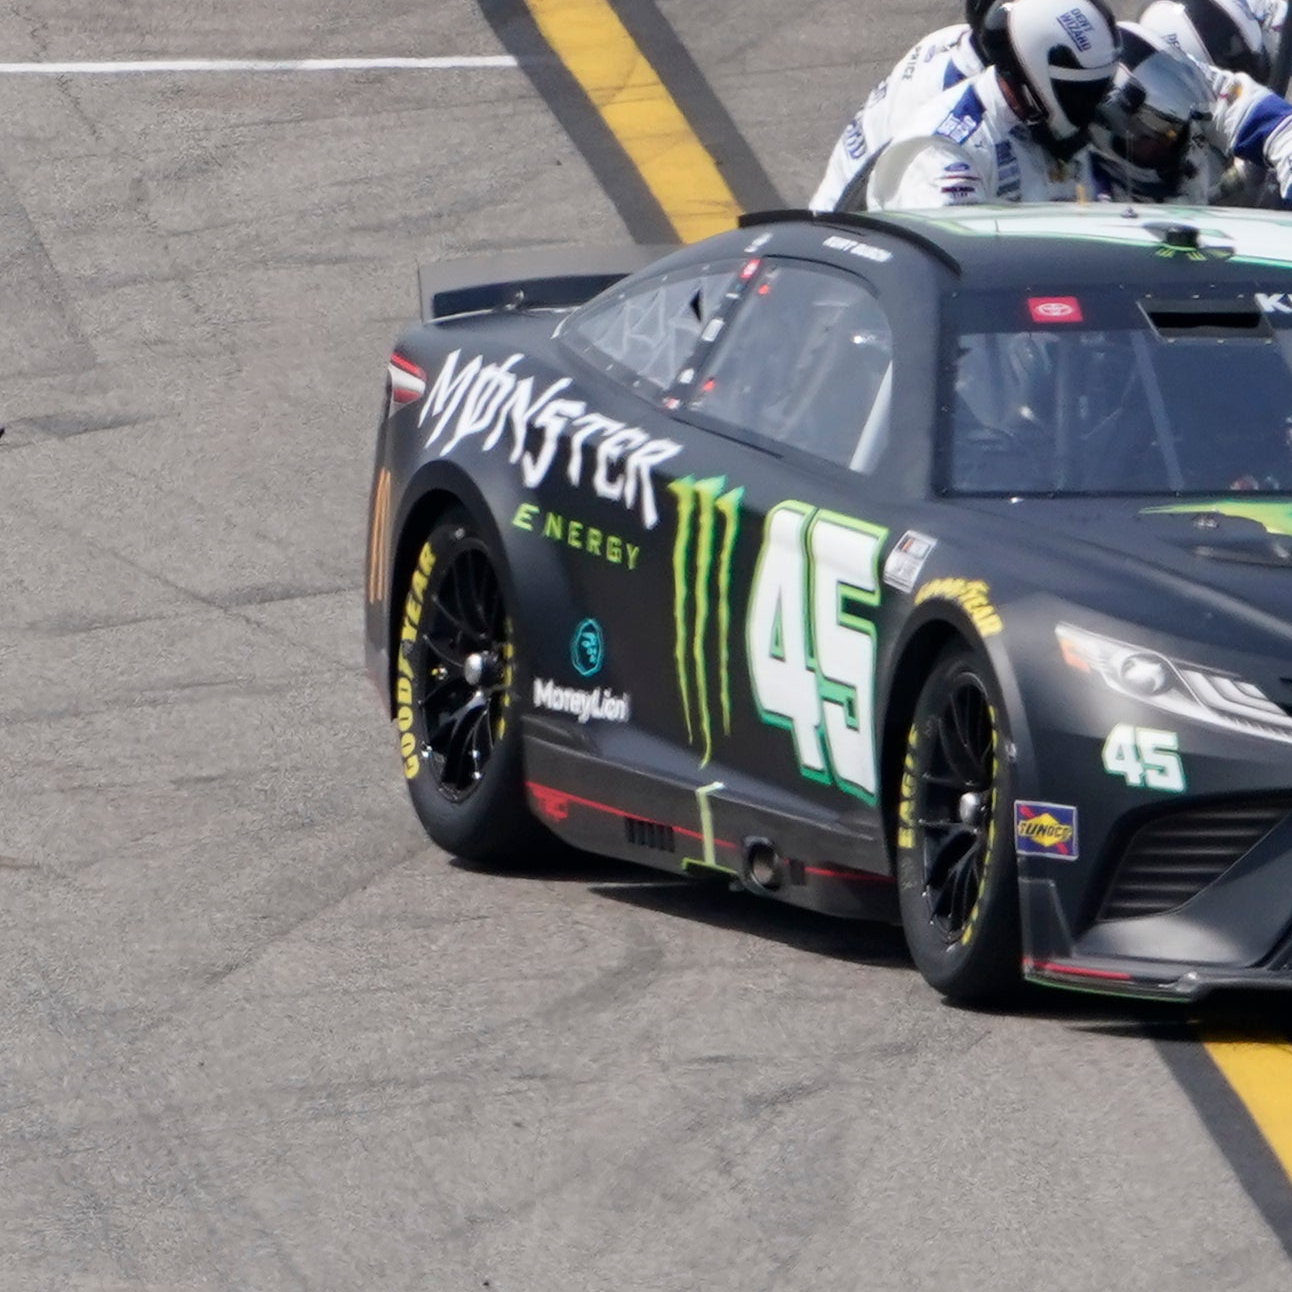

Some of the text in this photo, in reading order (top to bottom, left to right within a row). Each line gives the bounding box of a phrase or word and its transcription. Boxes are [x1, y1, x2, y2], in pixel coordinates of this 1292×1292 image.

[1060, 12, 1092, 52] WIZARD
[1070, 8, 1095, 33] DENT
[511, 503, 641, 571] ENERGY
[746, 499, 890, 806] 45
[533, 677, 632, 724] MoneyLion
[1102, 723, 1186, 793] 45
[1018, 819, 1071, 842] SUNOCO
